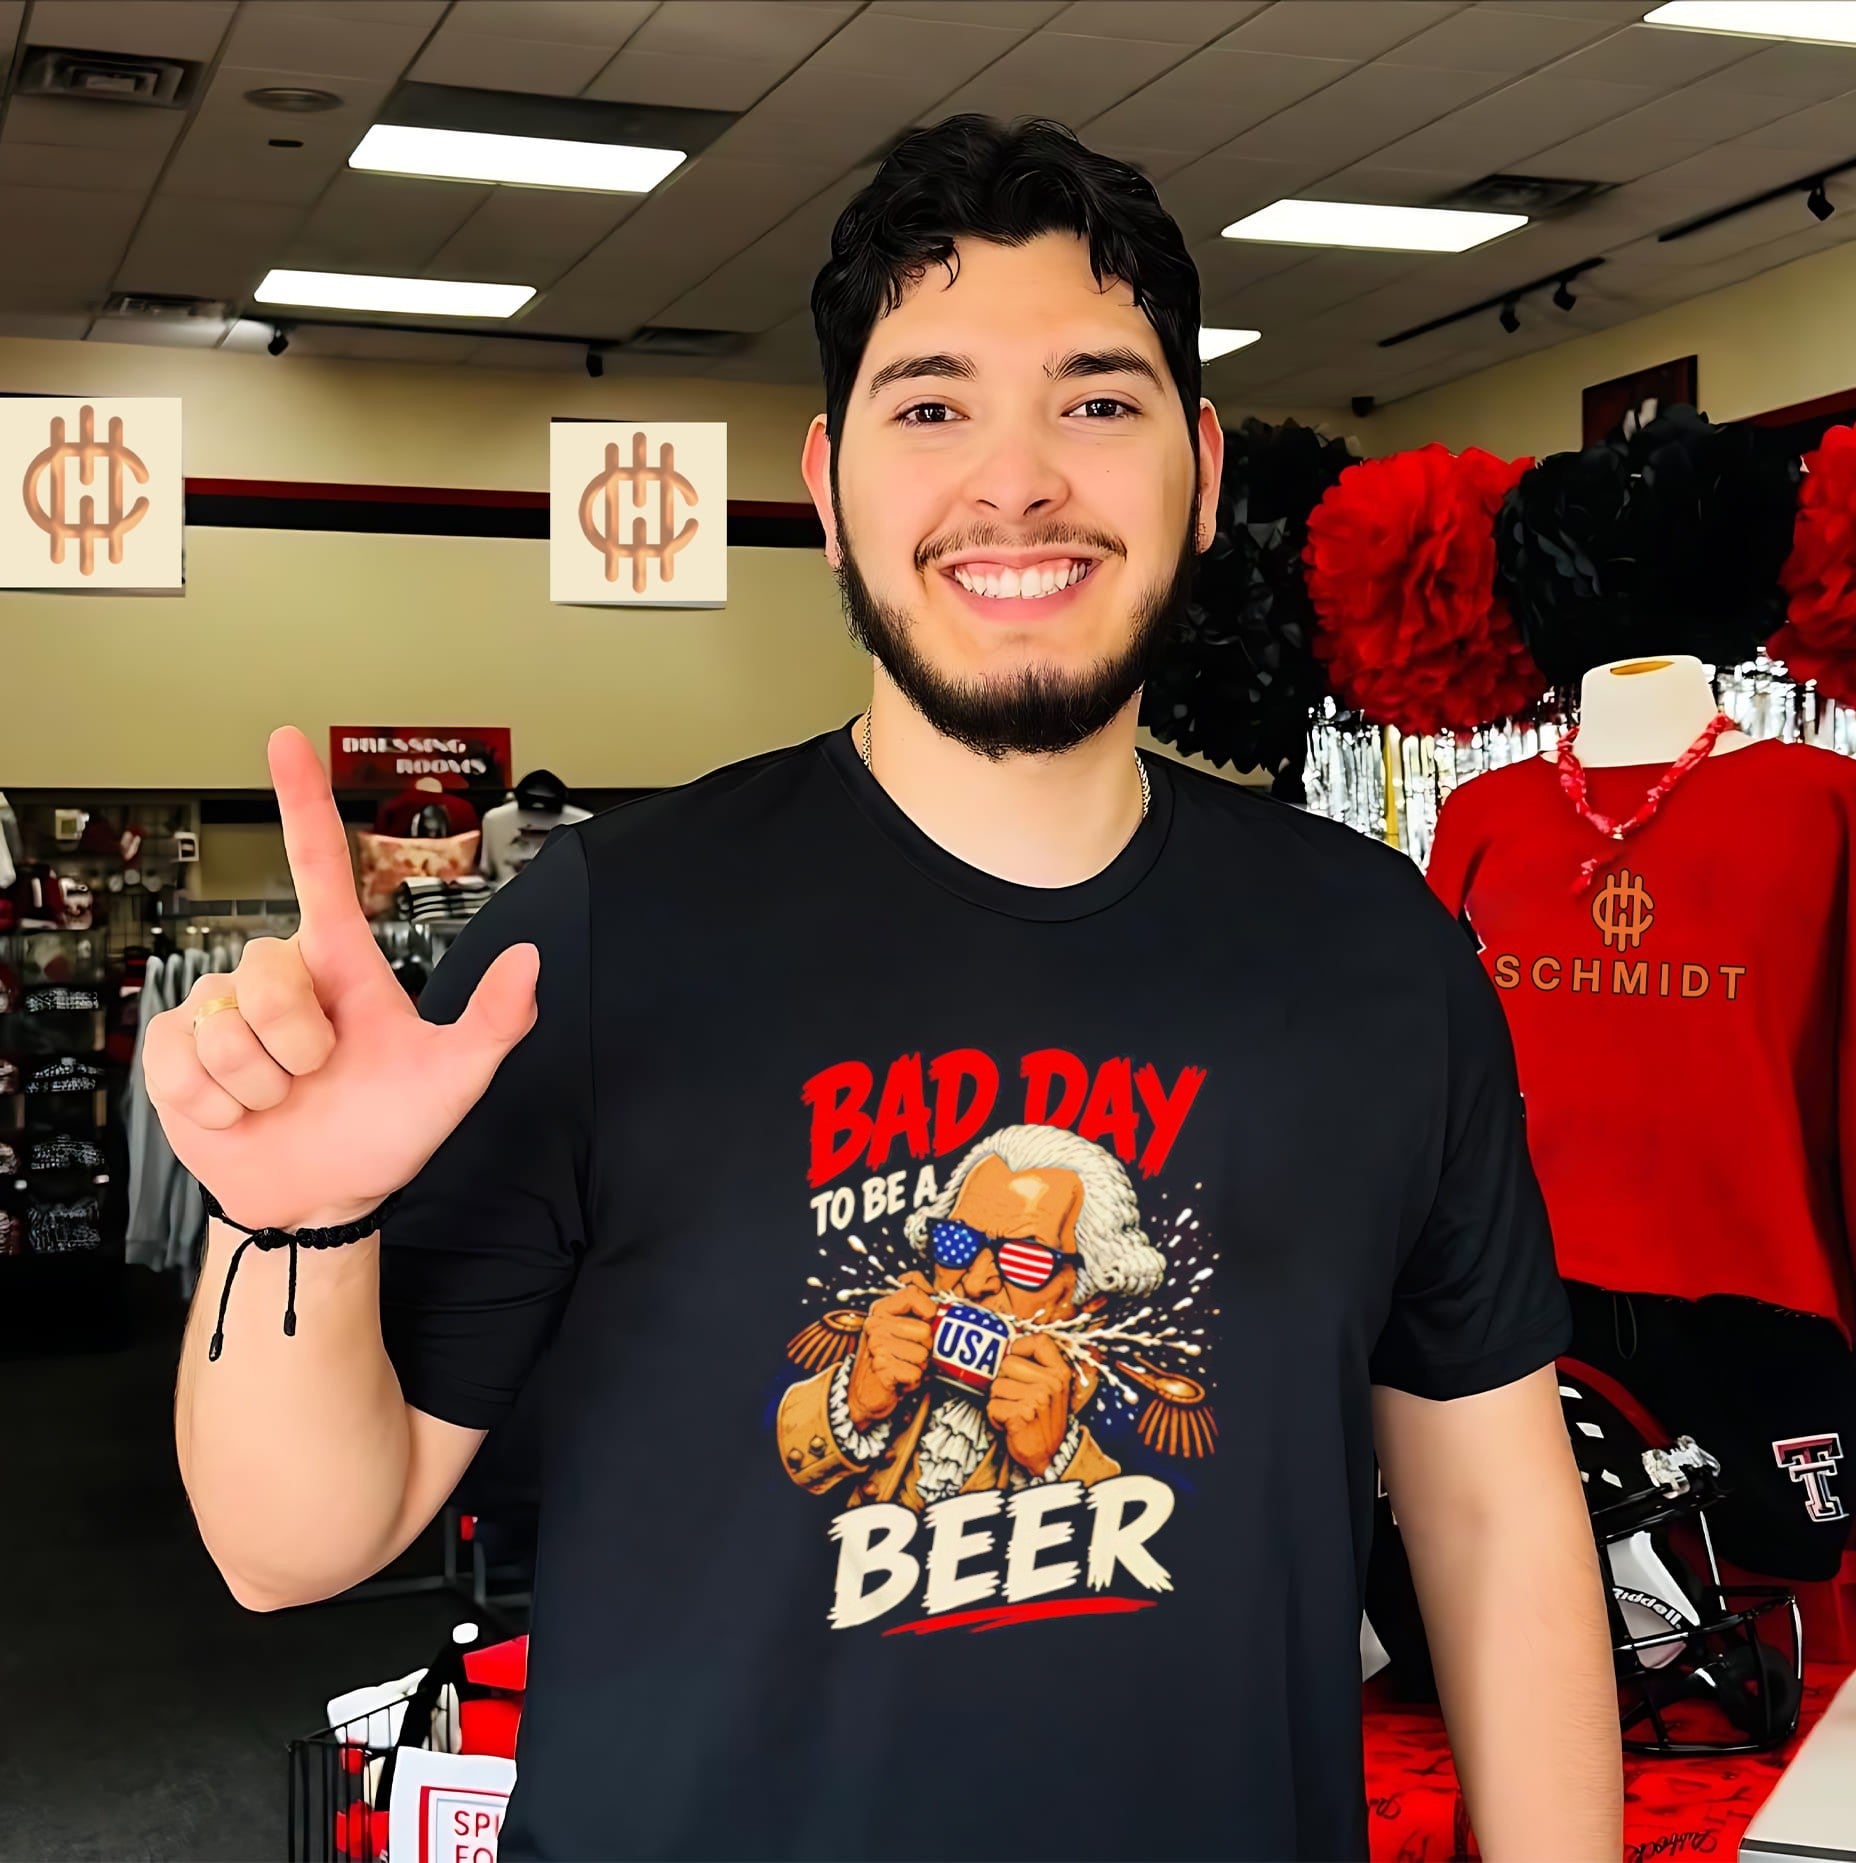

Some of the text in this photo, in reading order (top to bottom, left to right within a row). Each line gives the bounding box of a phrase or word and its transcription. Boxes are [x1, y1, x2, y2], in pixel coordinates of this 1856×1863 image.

[342, 737, 467, 753] DRESSING
[396, 758, 487, 774] ROOMS
[1494, 954, 1747, 1000] SCHMIDT
[801, 1047, 1207, 1189] BAD DAY
[810, 1164, 939, 1237] TO BE A
[937, 1321, 1000, 1376] USA
[826, 1474, 1175, 1630] BEER
